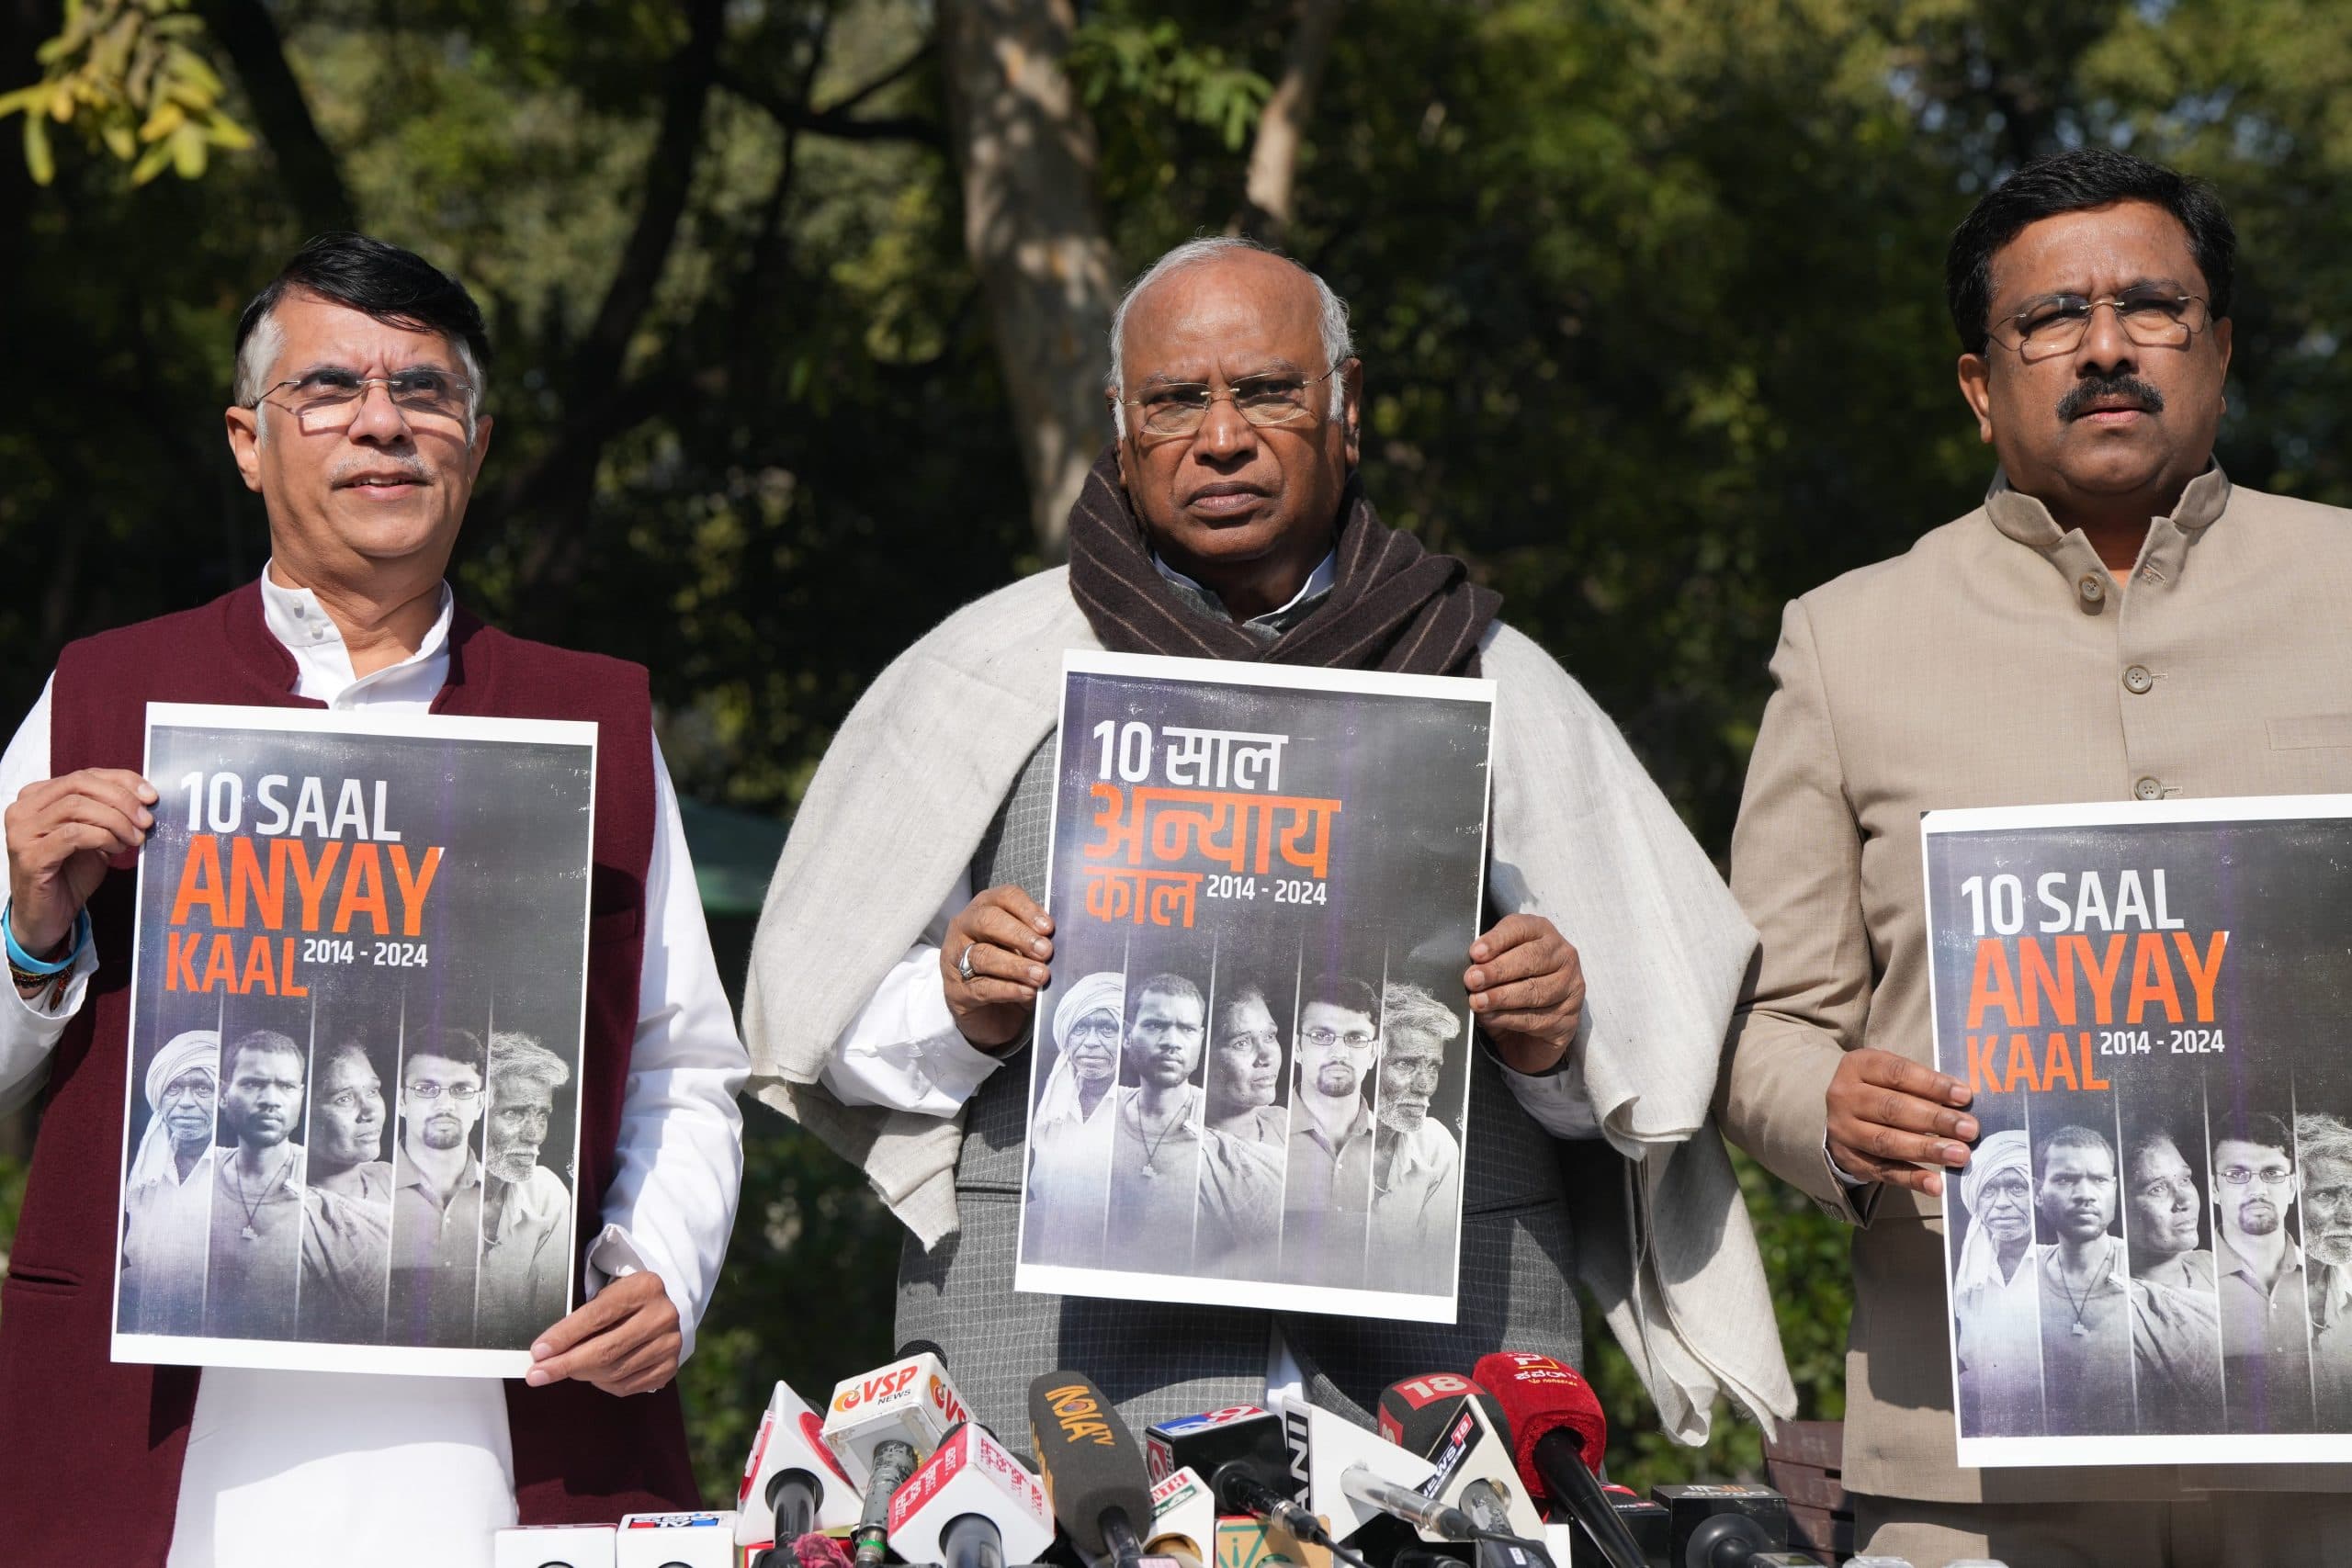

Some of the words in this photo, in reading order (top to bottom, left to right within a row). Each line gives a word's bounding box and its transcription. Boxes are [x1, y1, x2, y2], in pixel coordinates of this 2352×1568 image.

[1093, 720, 1152, 782] 10
[1162, 727, 1289, 791] साल
[180, 772, 243, 833] 10
[256, 774, 401, 841] SAAL
[1083, 783, 1341, 878] अन्याय
[170, 835, 445, 936] ANYAY
[1082, 866, 1204, 928] काल
[1206, 874, 1255, 900] 2014
[1274, 880, 1327, 905] 2024
[1961, 874, 2024, 935] 10
[2037, 869, 2185, 933] SAAL
[165, 932, 309, 997] KAAL
[303, 939, 354, 964] 2014
[374, 942, 428, 967] 2024
[1966, 931, 2230, 1029] ANYAY
[1966, 1032, 2109, 1093] KAAL
[2100, 1031, 2151, 1055] 2014
[2171, 1030, 2225, 1054] 2024
[863, 1366, 918, 1403] VSP
[877, 1389, 911, 1405] NEWS
[1403, 1376, 1467, 1398] 18
